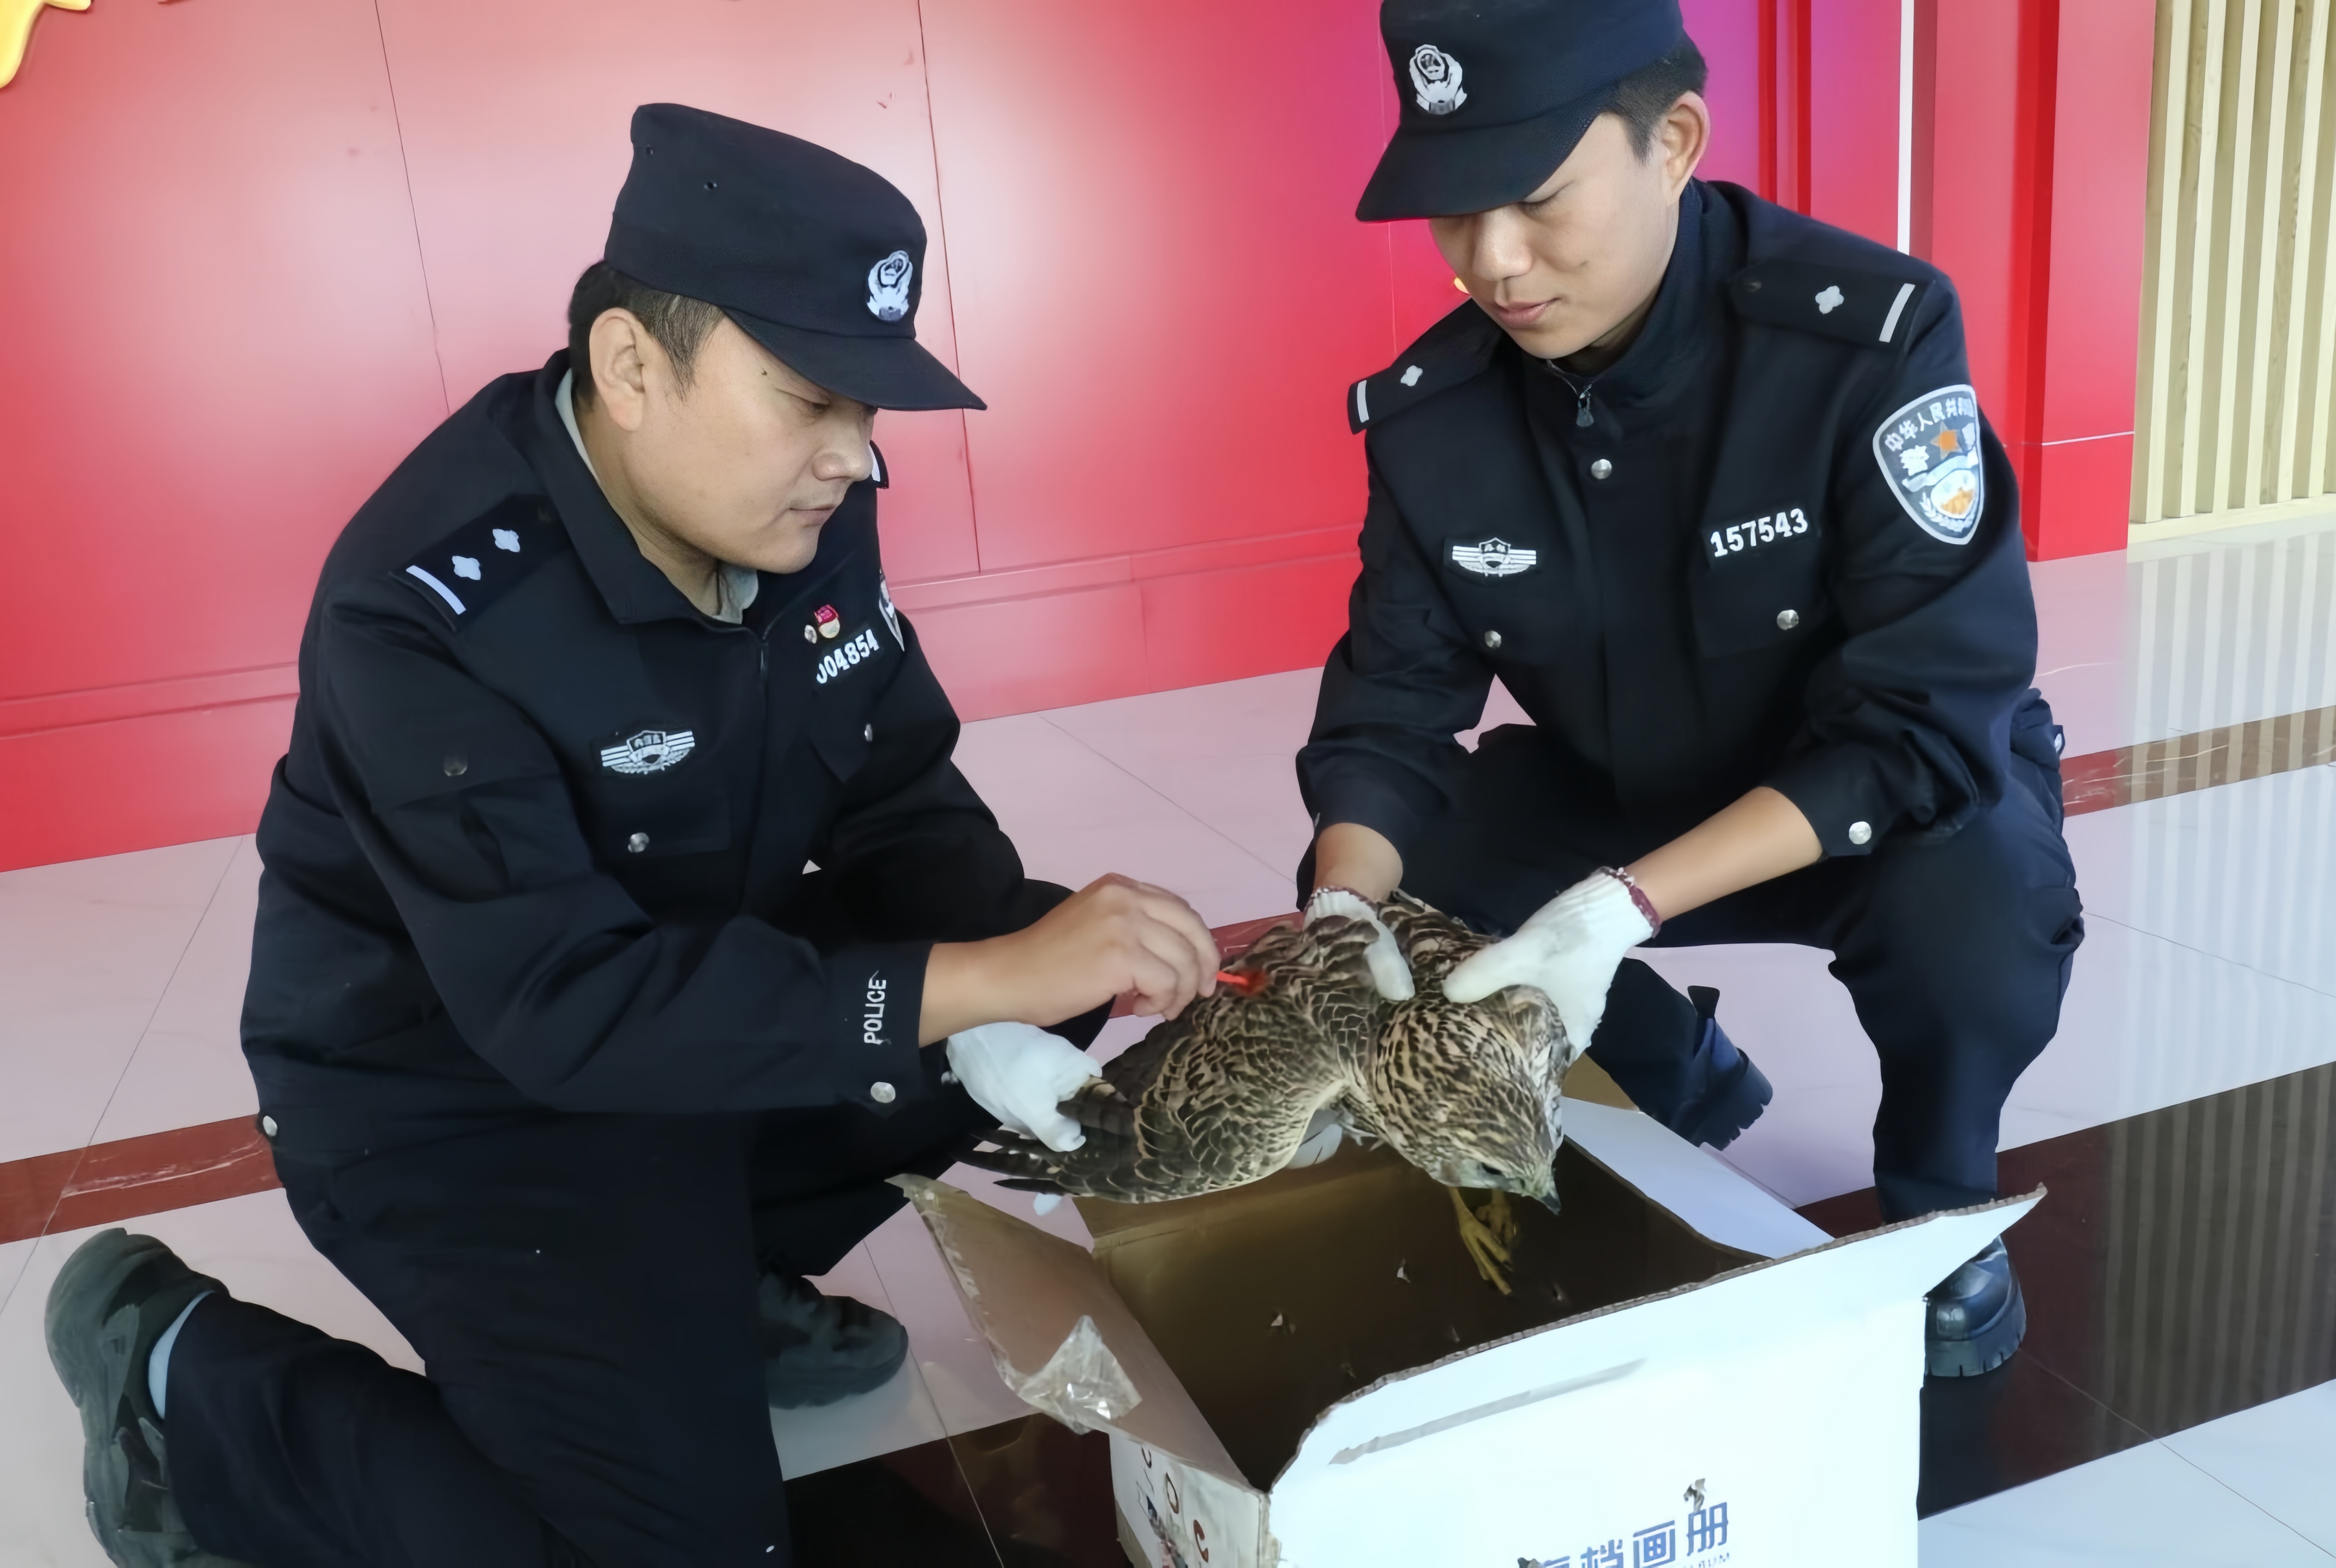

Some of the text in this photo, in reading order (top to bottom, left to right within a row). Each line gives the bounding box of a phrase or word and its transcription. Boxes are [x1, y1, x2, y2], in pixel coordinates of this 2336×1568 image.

[1710, 508, 1808, 557] 157543
[816, 628, 880, 684] J04854
[863, 977, 887, 1045] POLICE
[1542, 1501, 1729, 1568] 档画册
